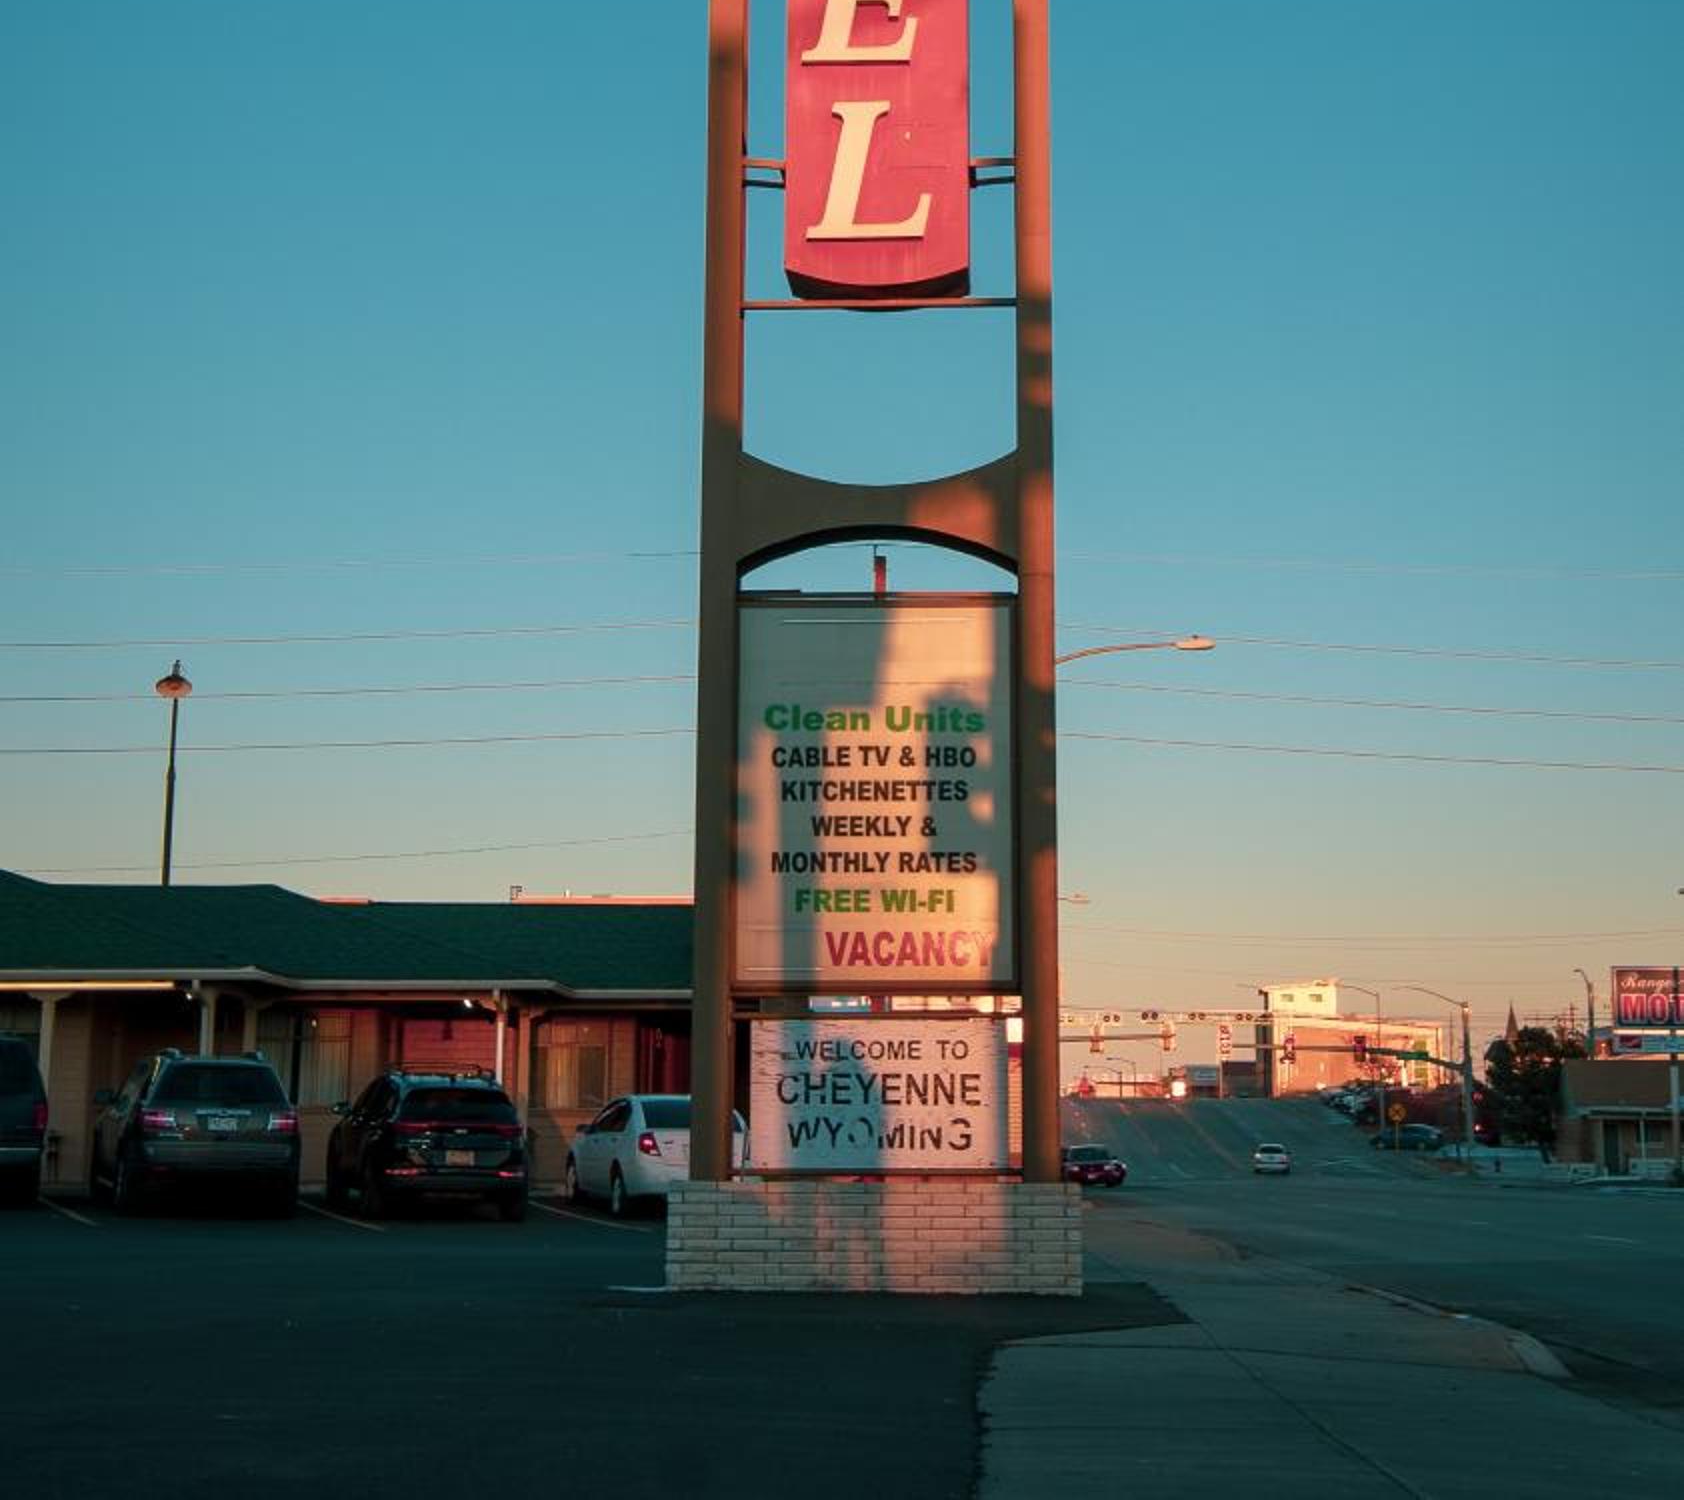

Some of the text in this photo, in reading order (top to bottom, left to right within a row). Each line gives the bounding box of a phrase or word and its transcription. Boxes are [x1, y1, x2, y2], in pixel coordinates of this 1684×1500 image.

[764, 704, 985, 733] Clean Units
[771, 746, 976, 768] CABLE TV & HBO
[781, 780, 968, 801] KITCHENETTES
[811, 816, 937, 837] WEEKLY &
[771, 851, 977, 873] MONTHLY RATES
[795, 889, 955, 913] FREE WI-FI
[825, 931, 992, 967] VACANCY
[796, 1040, 969, 1061] WELCOME TO
[777, 1073, 981, 1105] CHEYENNE
